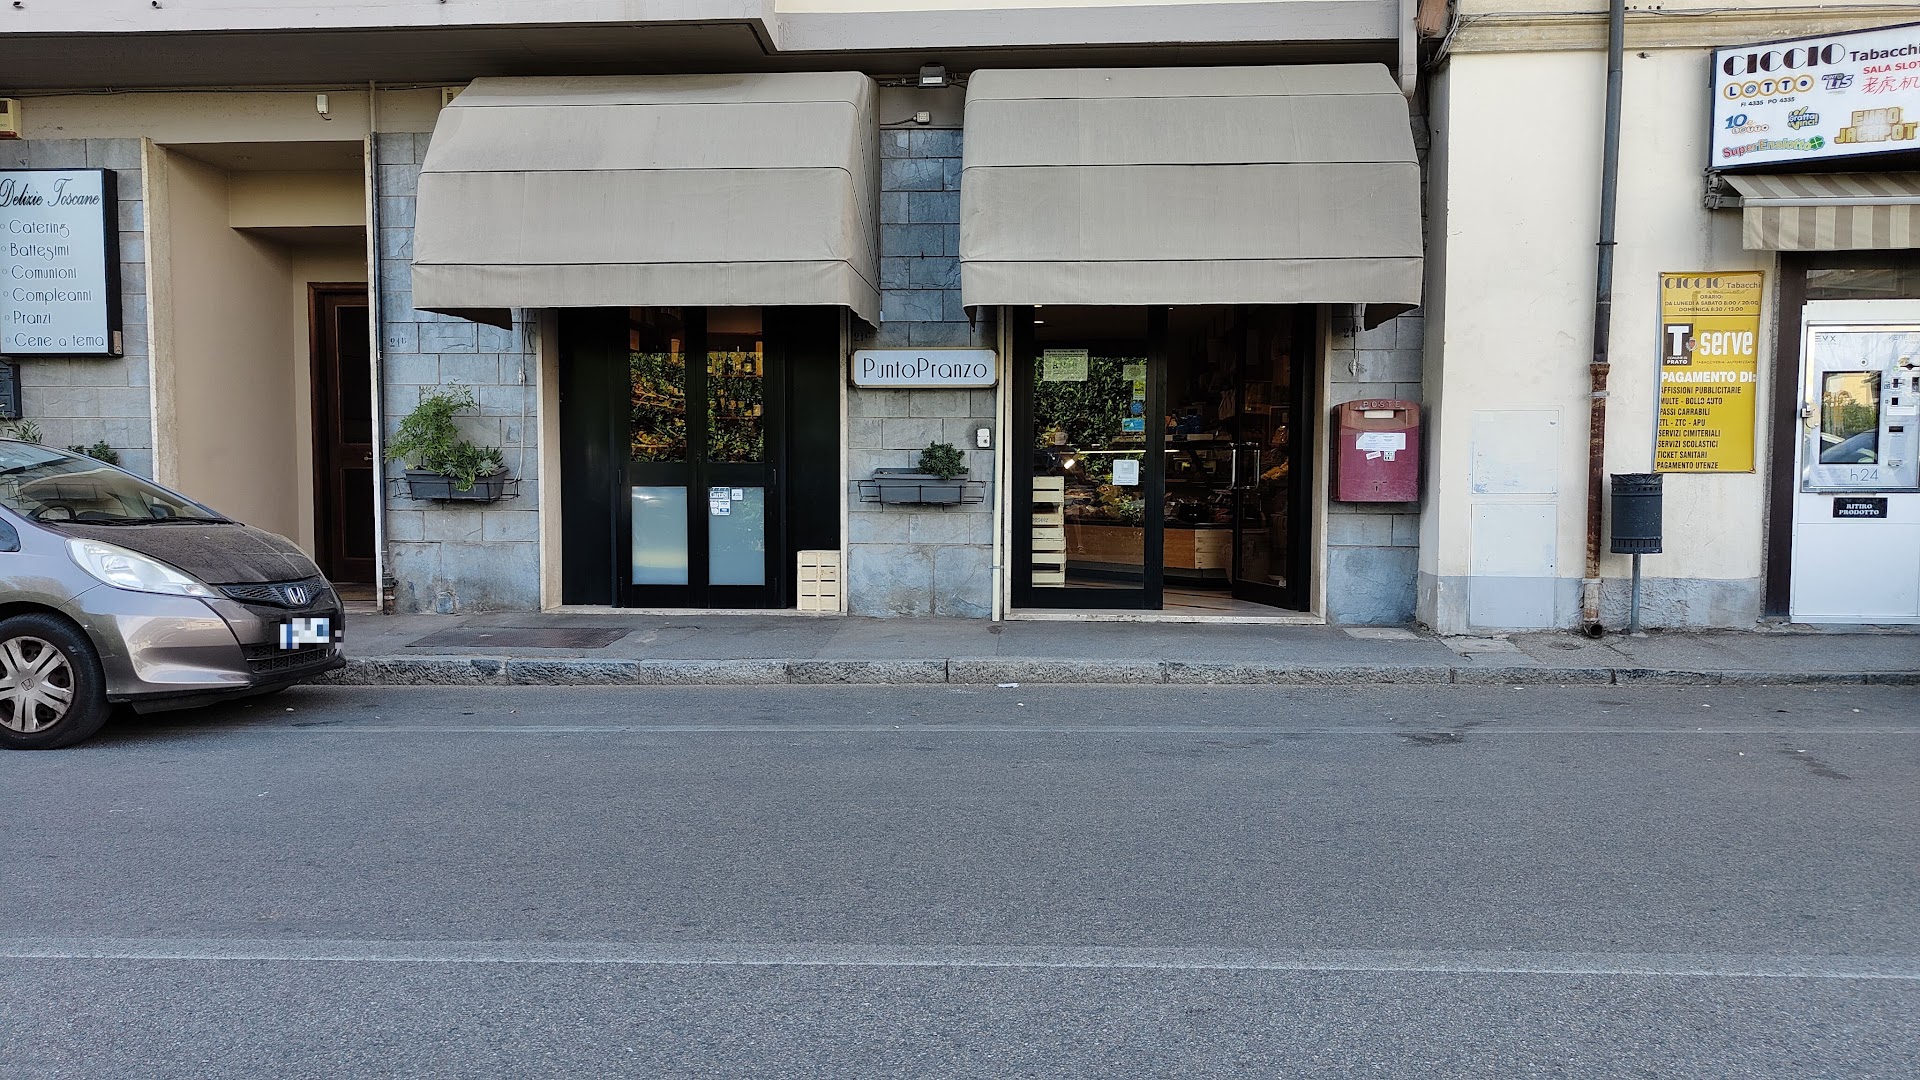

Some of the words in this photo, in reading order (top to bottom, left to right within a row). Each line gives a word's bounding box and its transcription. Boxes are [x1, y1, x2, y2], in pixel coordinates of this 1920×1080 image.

[1723, 43, 1846, 77] CICCIO
[1863, 64, 1891, 74] SALA
[1723, 75, 1814, 100] LOTTO
[1725, 114, 1748, 129] 10
[1789, 113, 1815, 122] Gratta
[1851, 106, 1901, 126] EURO
[0, 178, 43, 207] Delizie
[48, 178, 100, 207] Toscane
[9, 219, 70, 238] Catering
[10, 243, 69, 261] Battesimi
[11, 265, 77, 279] Comunioni
[1665, 277, 1724, 289] CICCIO
[1726, 281, 1761, 289] Tabacchi
[12, 287, 92, 305] Compleanni
[13, 311, 51, 324] Pranzi
[14, 333, 52, 347] Cene
[58, 338, 67, 347] a
[72, 334, 104, 347] tema
[1667, 326, 1690, 356] T
[1700, 331, 1753, 356] serve
[863, 357, 988, 378] PuntoPranzo
[1661, 371, 1736, 383] PAGAMENTO
[1740, 371, 1756, 383] DI:
[1661, 397, 1679, 405] MULTE
[1685, 397, 1705, 405] BOLLO
[1706, 397, 1722, 405] AUTO
[1658, 429, 1681, 437] SERVIZI
[1683, 429, 1721, 437] CIMITERIALI
[1658, 440, 1681, 448] SERVIZI
[1682, 440, 1718, 448] SCOLASTICI
[1657, 451, 1678, 459] TICKET
[1679, 451, 1707, 459] SANITARI
[1849, 468, 1879, 481] h24
